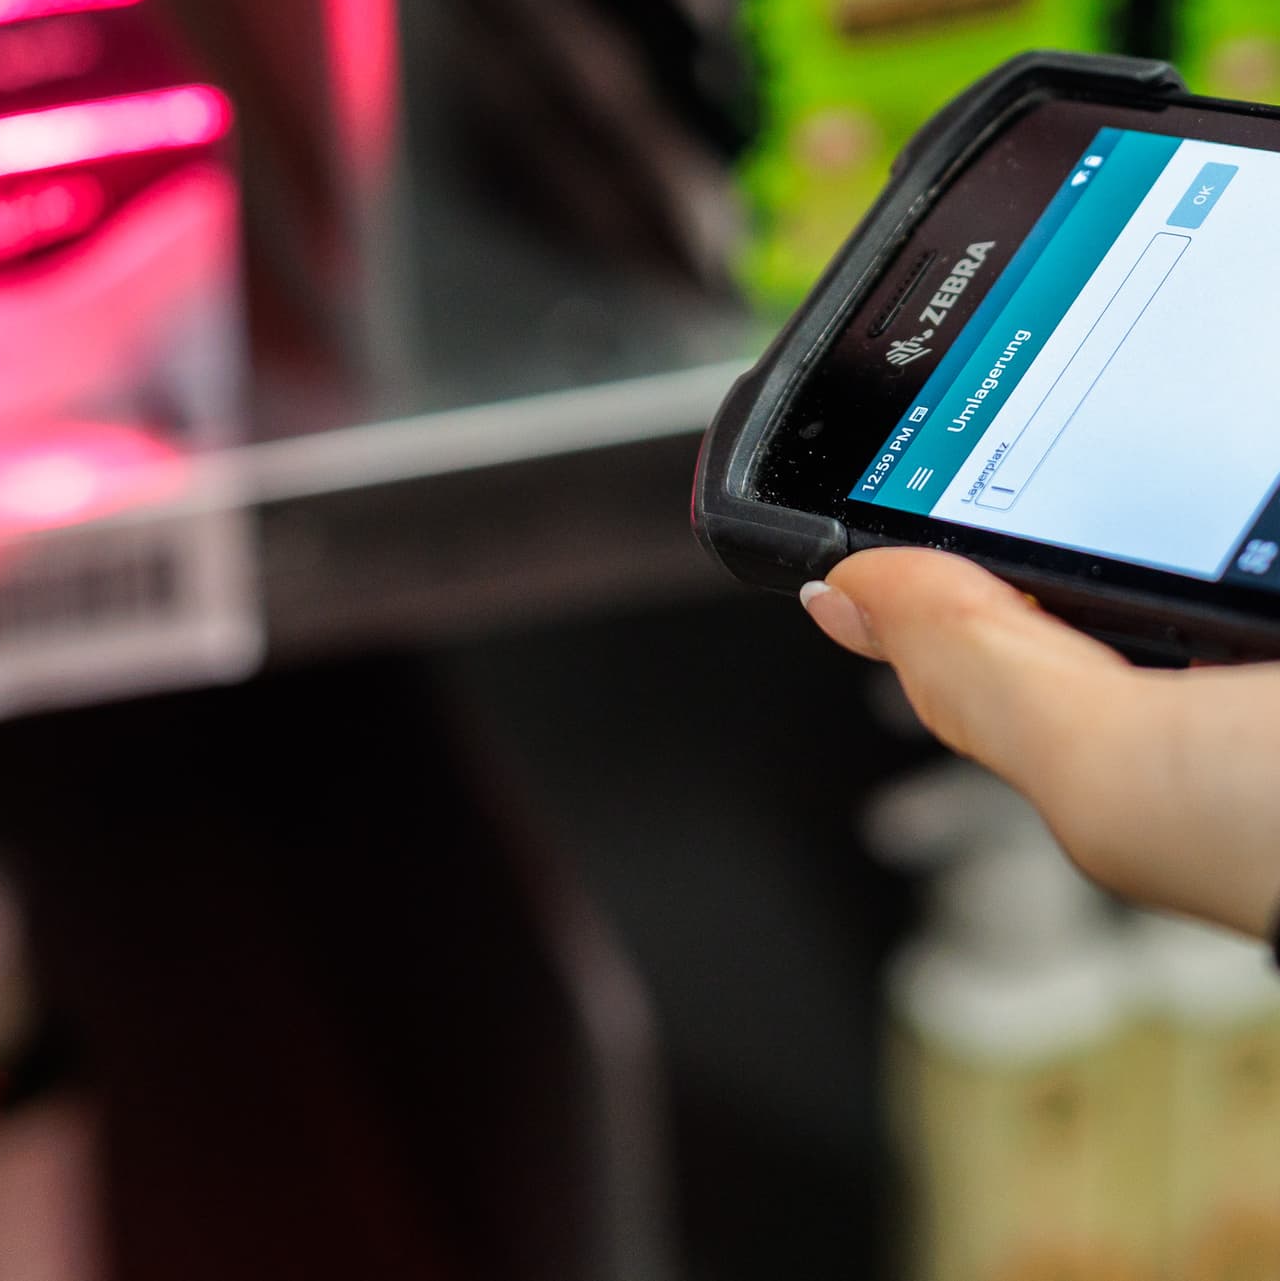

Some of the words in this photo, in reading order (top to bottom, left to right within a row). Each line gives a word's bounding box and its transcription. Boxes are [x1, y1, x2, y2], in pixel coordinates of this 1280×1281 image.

[1192, 184, 1216, 206] OK
[919, 240, 996, 326] ZEBRA
[947, 328, 1032, 434] Umlagerung
[861, 453, 895, 492] 12:59
[889, 426, 915, 451] PM
[961, 441, 1010, 504] Lagerplatz
